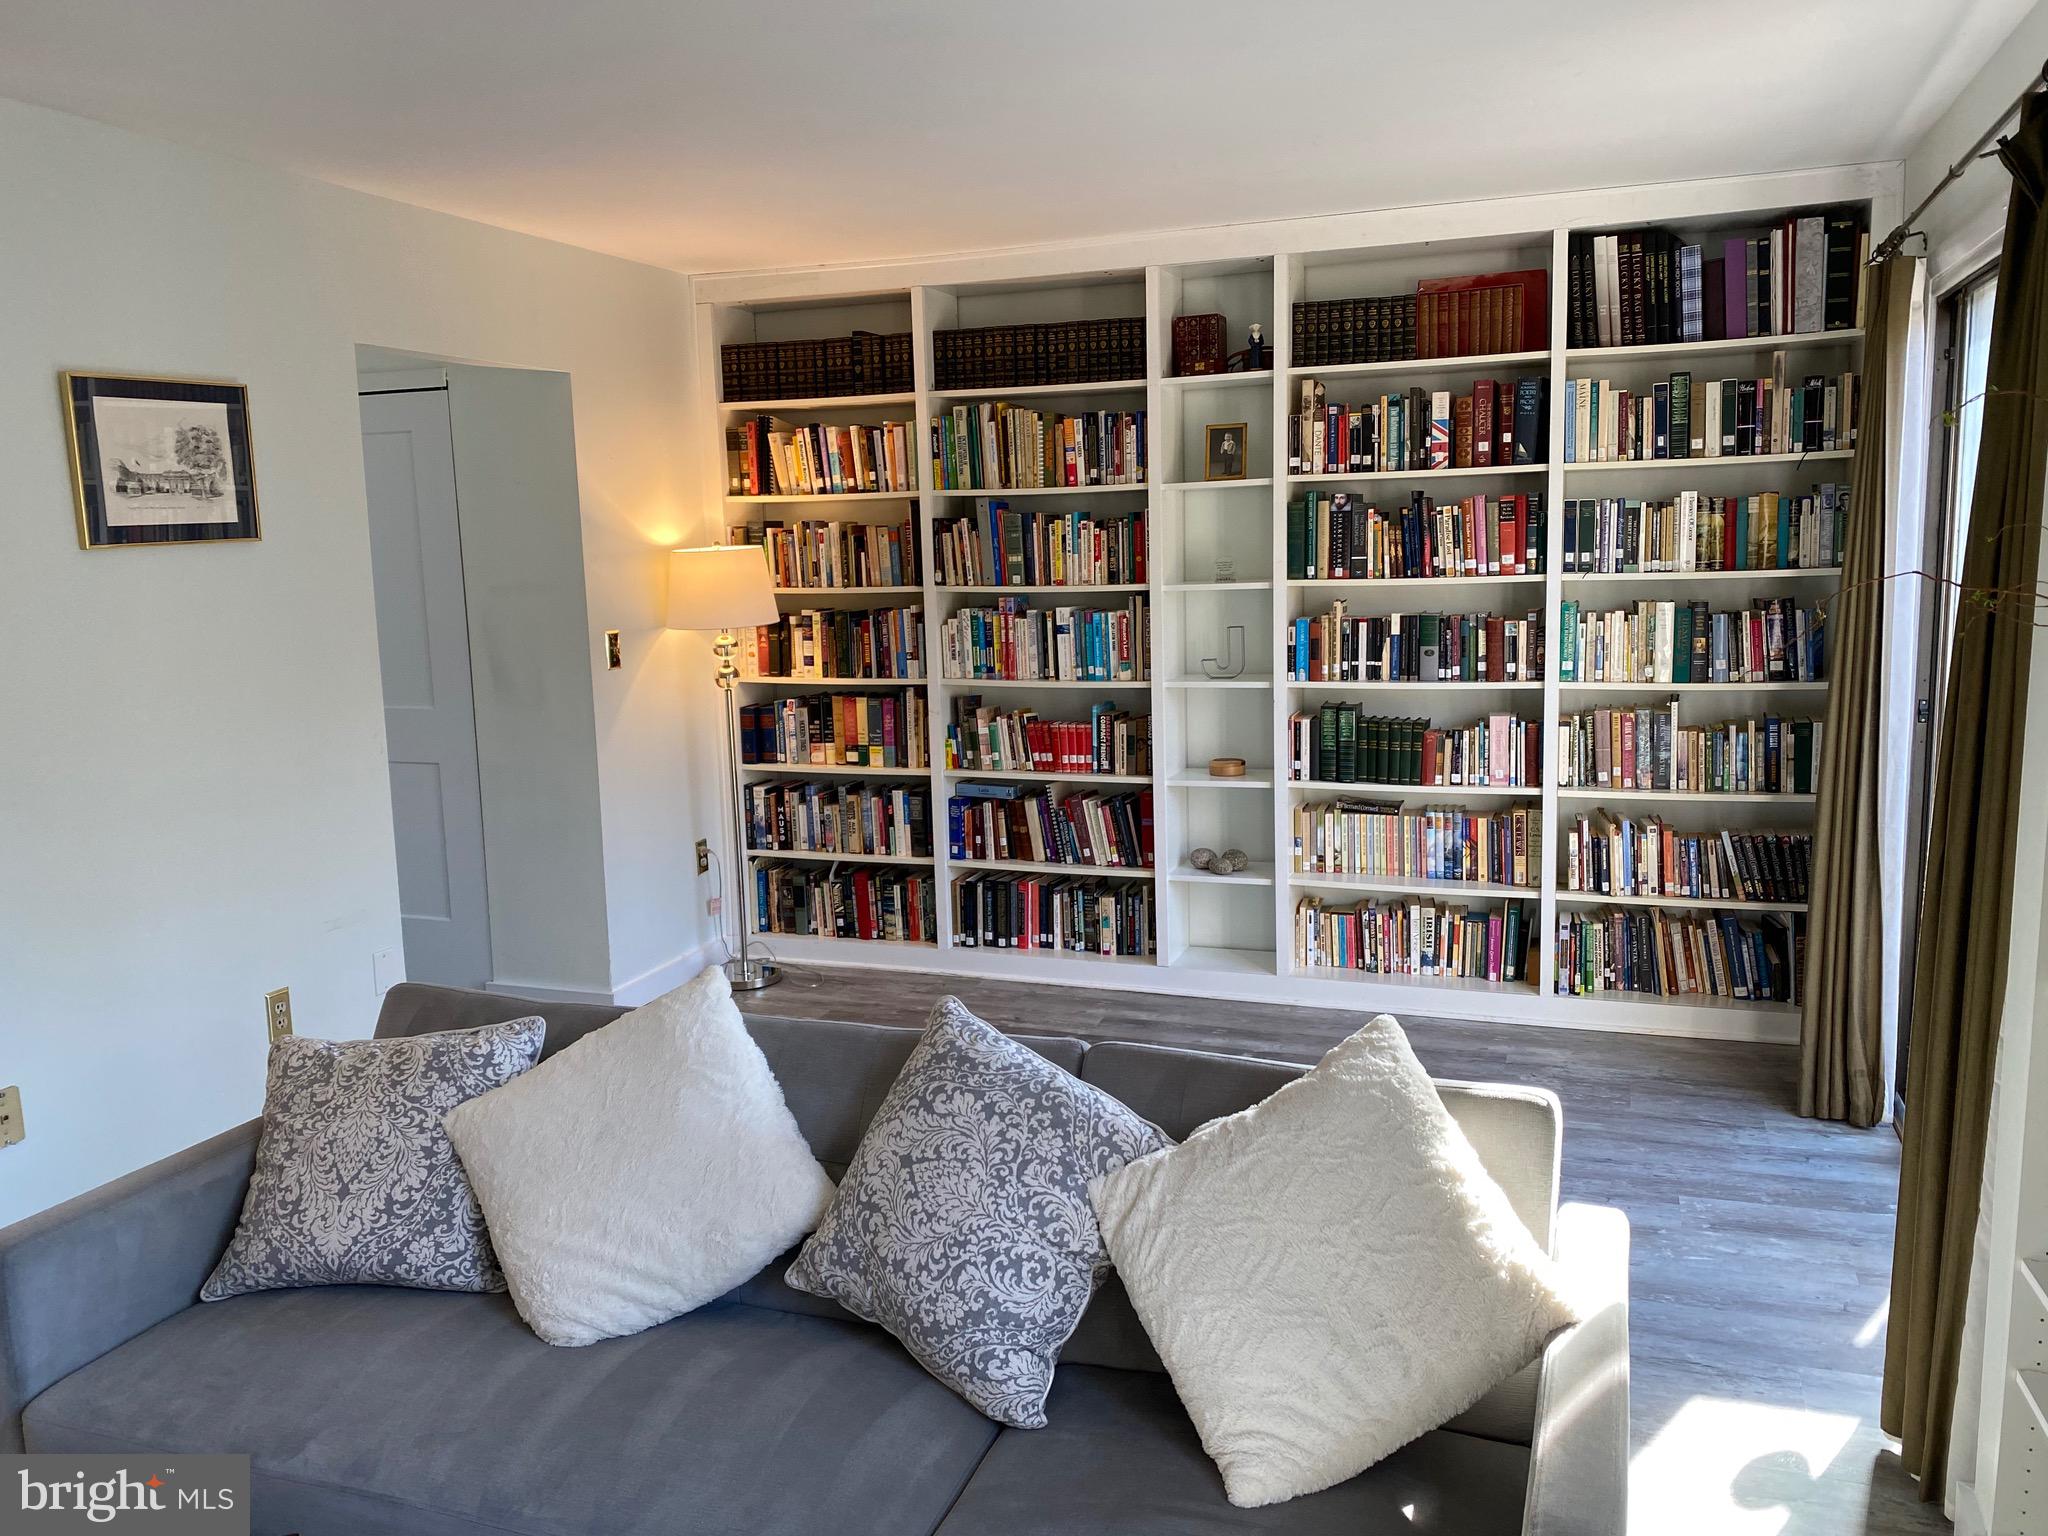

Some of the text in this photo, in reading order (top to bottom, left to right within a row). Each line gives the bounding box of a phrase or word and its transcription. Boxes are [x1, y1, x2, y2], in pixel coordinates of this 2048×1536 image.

[1633, 258, 1641, 289] LUCKY
[1478, 398, 1486, 435] CHAUCER
[1314, 430, 1322, 456] DANTE
[1444, 515, 1452, 541] Paradise
[1201, 626, 1245, 679] J
